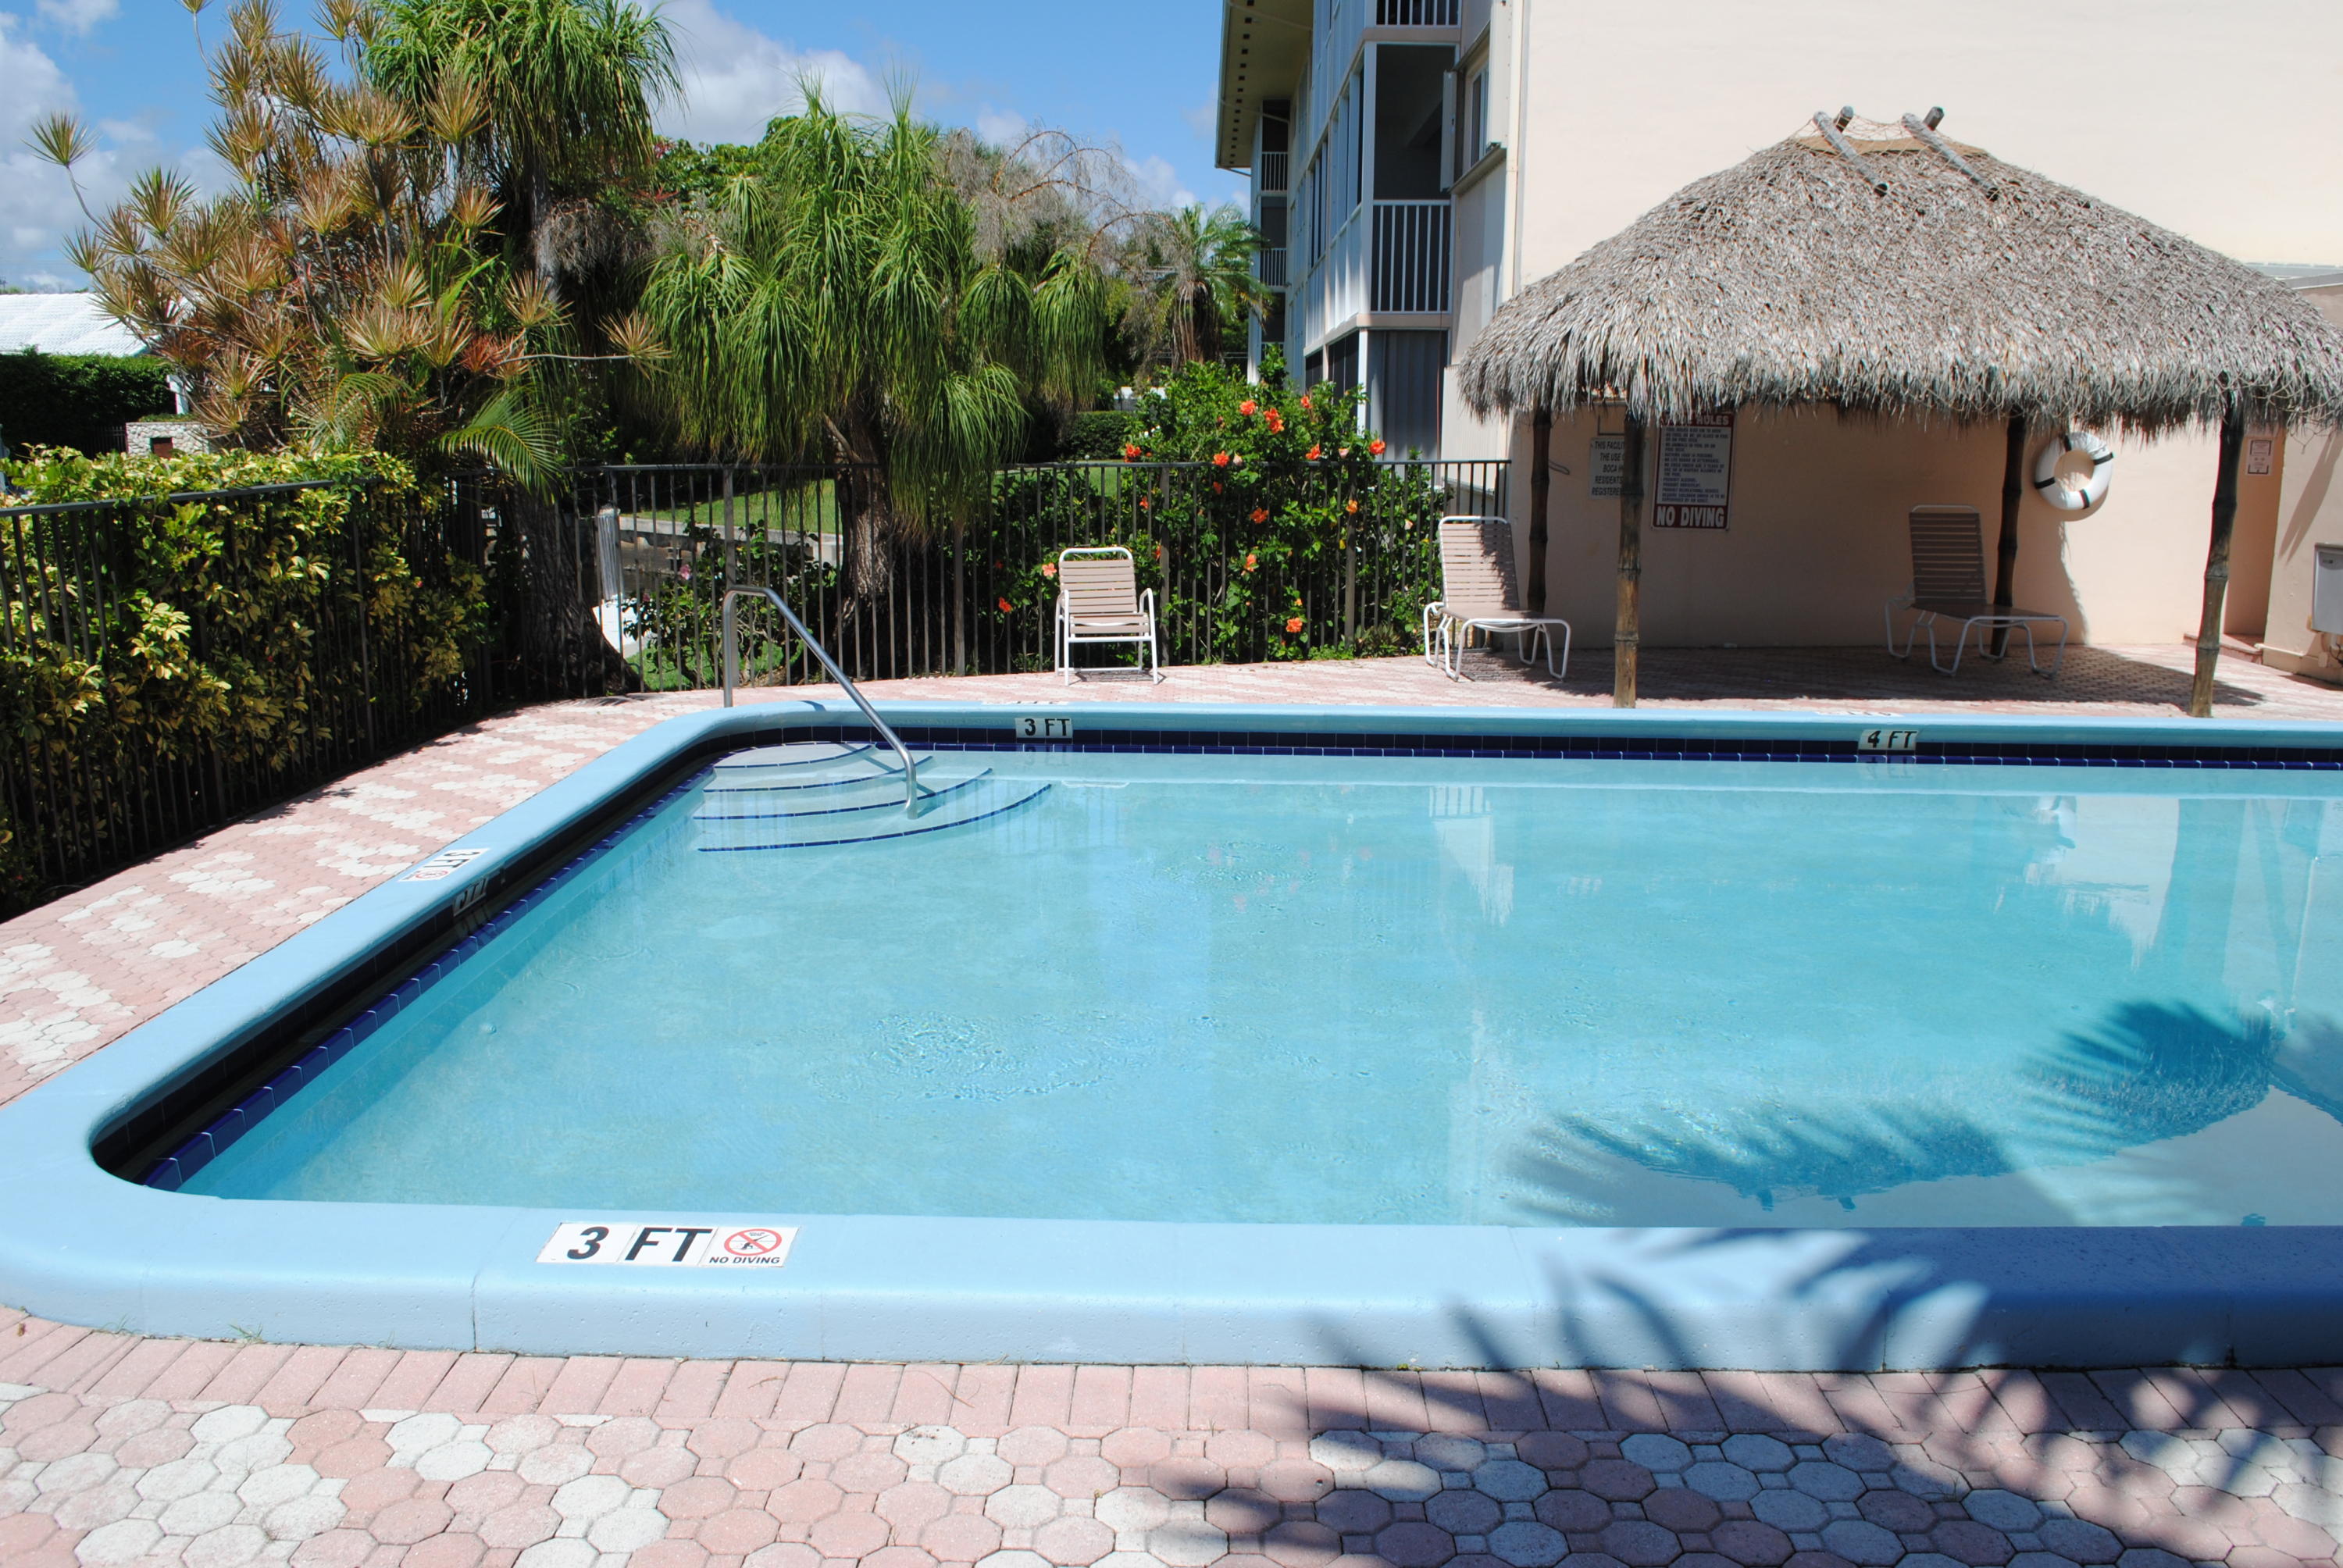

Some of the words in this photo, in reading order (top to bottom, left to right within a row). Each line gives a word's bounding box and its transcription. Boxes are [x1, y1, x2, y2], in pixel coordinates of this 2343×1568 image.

[1595, 441, 1606, 450] THIS
[1600, 453, 1610, 461] THE
[1610, 453, 1621, 461] USE
[1603, 464, 1617, 472] BOCA
[1592, 487, 1621, 496] REGISTERE
[1656, 506, 1675, 526] NO
[1680, 507, 1724, 527] DIVING
[1025, 718, 1036, 736] 3
[1044, 718, 1070, 736] FT
[1867, 730, 1881, 748] 4
[1888, 731, 1917, 748] FT
[567, 1226, 610, 1260] 3
[624, 1227, 714, 1263] FT
